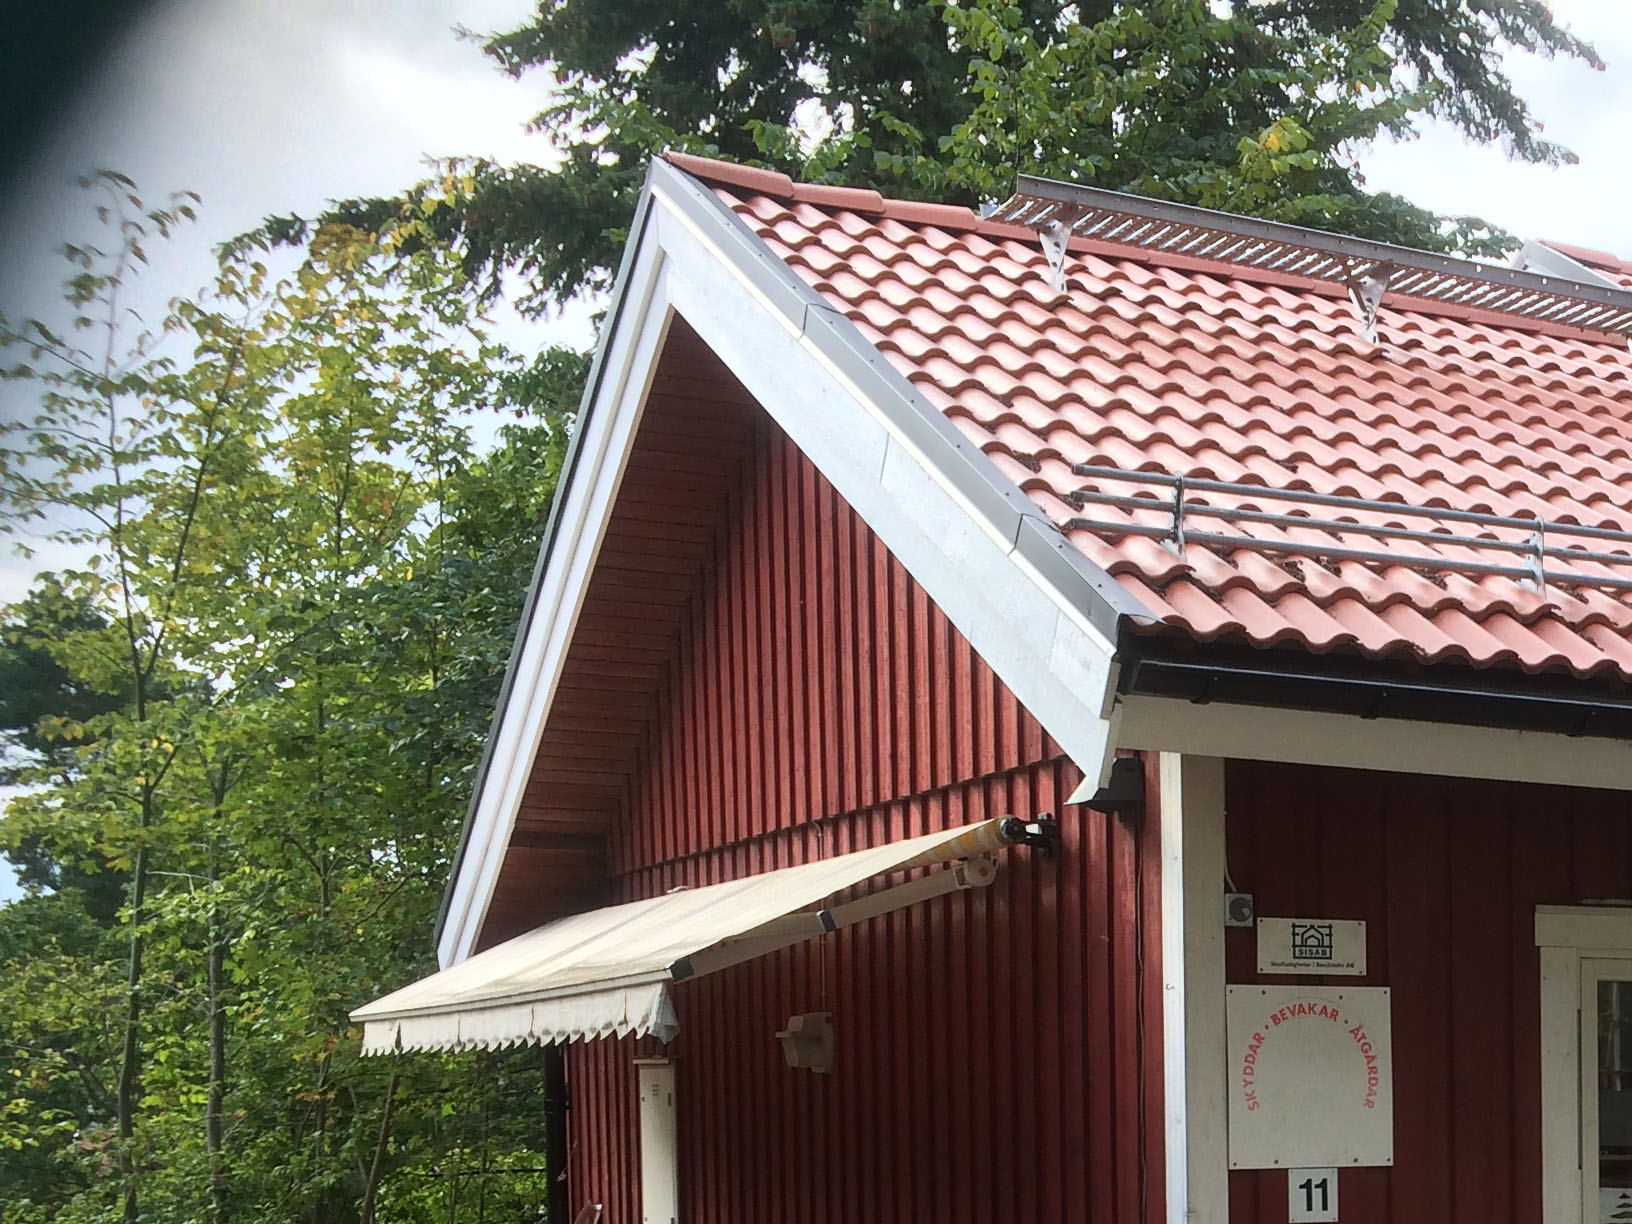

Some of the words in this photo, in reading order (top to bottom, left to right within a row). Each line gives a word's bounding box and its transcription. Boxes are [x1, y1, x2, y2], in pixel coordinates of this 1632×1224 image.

[1297, 948, 1328, 956] SISAB
[1242, 1032, 1265, 1111] SKYDDAR
[1270, 1003, 1339, 1026] BEVAKAR
[1299, 1178, 1328, 1211] 11
